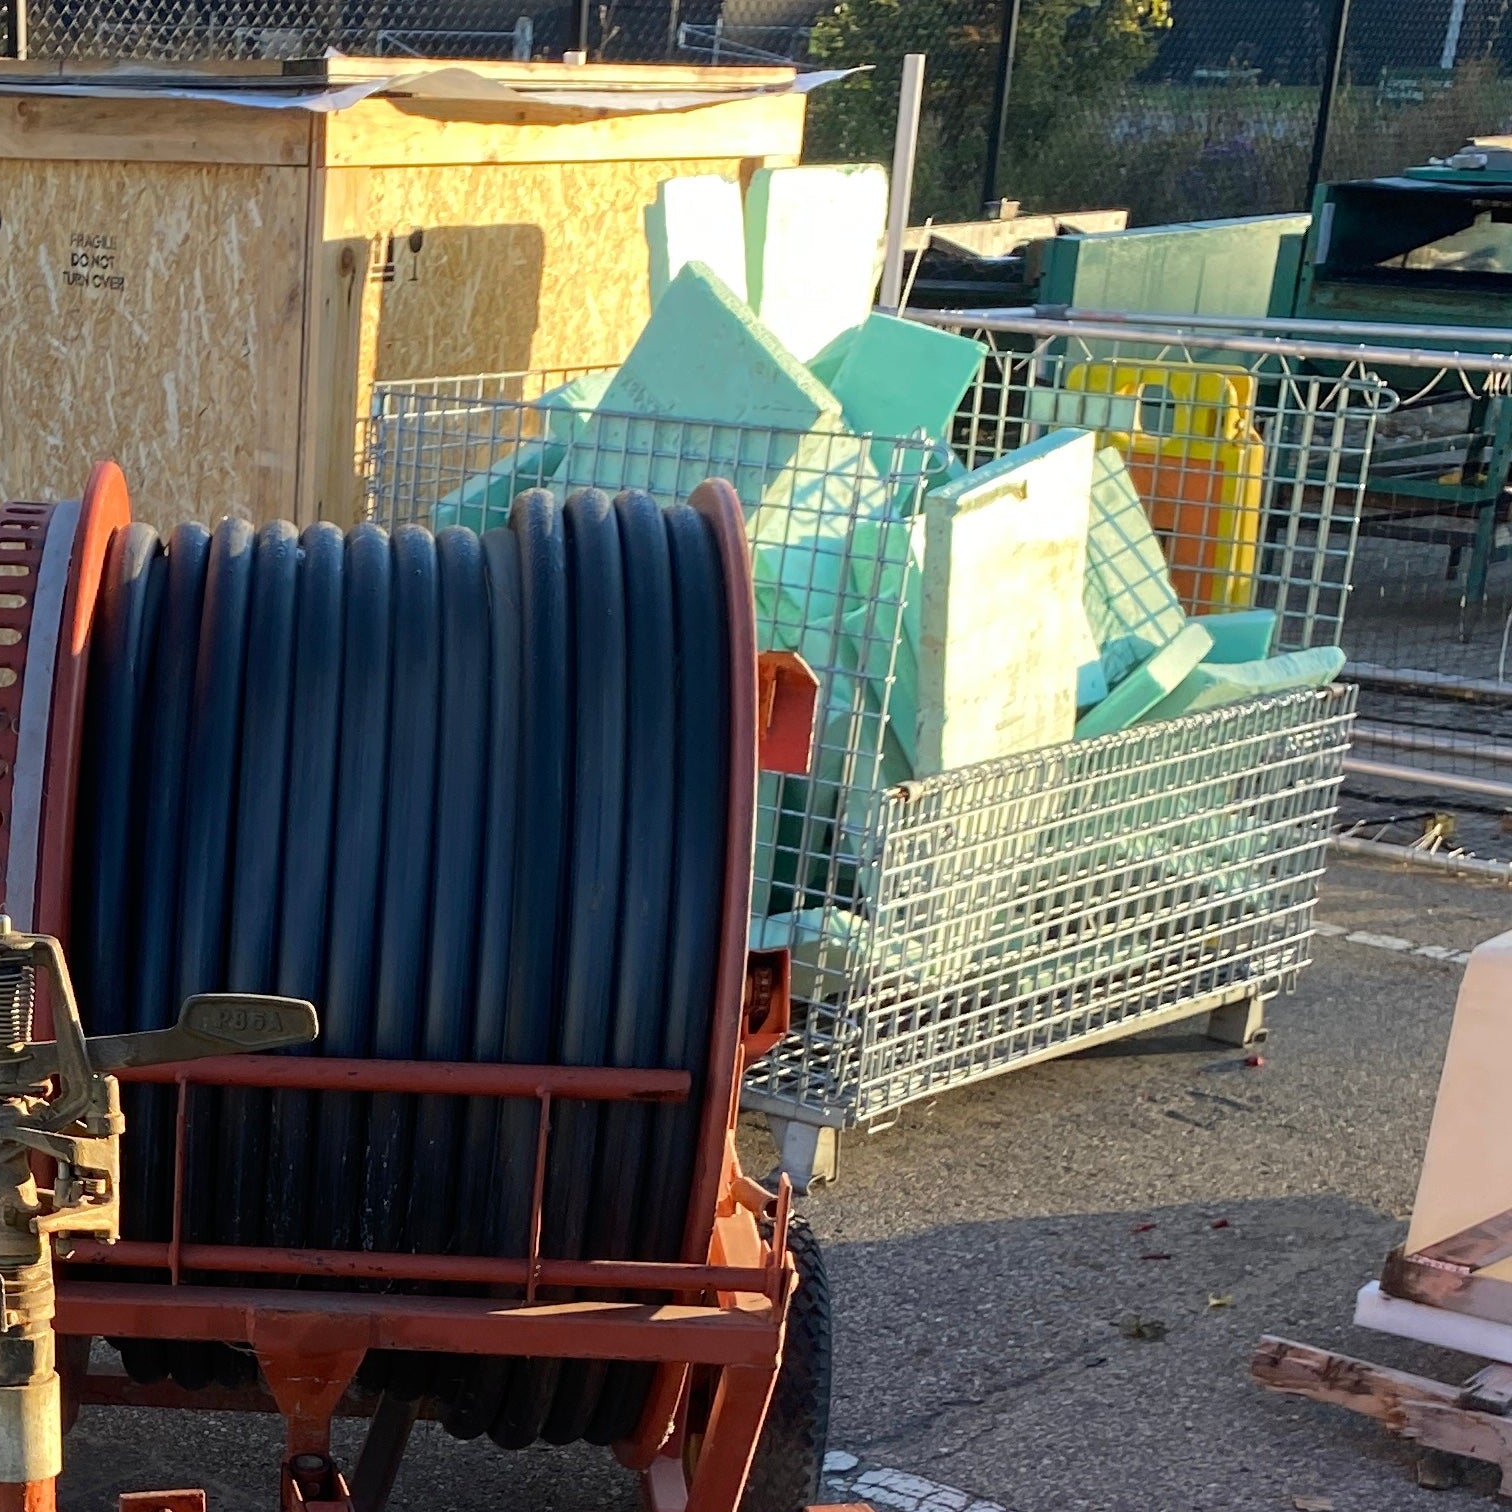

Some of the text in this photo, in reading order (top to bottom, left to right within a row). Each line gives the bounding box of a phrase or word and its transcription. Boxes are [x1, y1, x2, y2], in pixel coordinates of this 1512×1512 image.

[71, 253, 115, 269] DO NOT
[63, 271, 124, 291] TURN OVER
